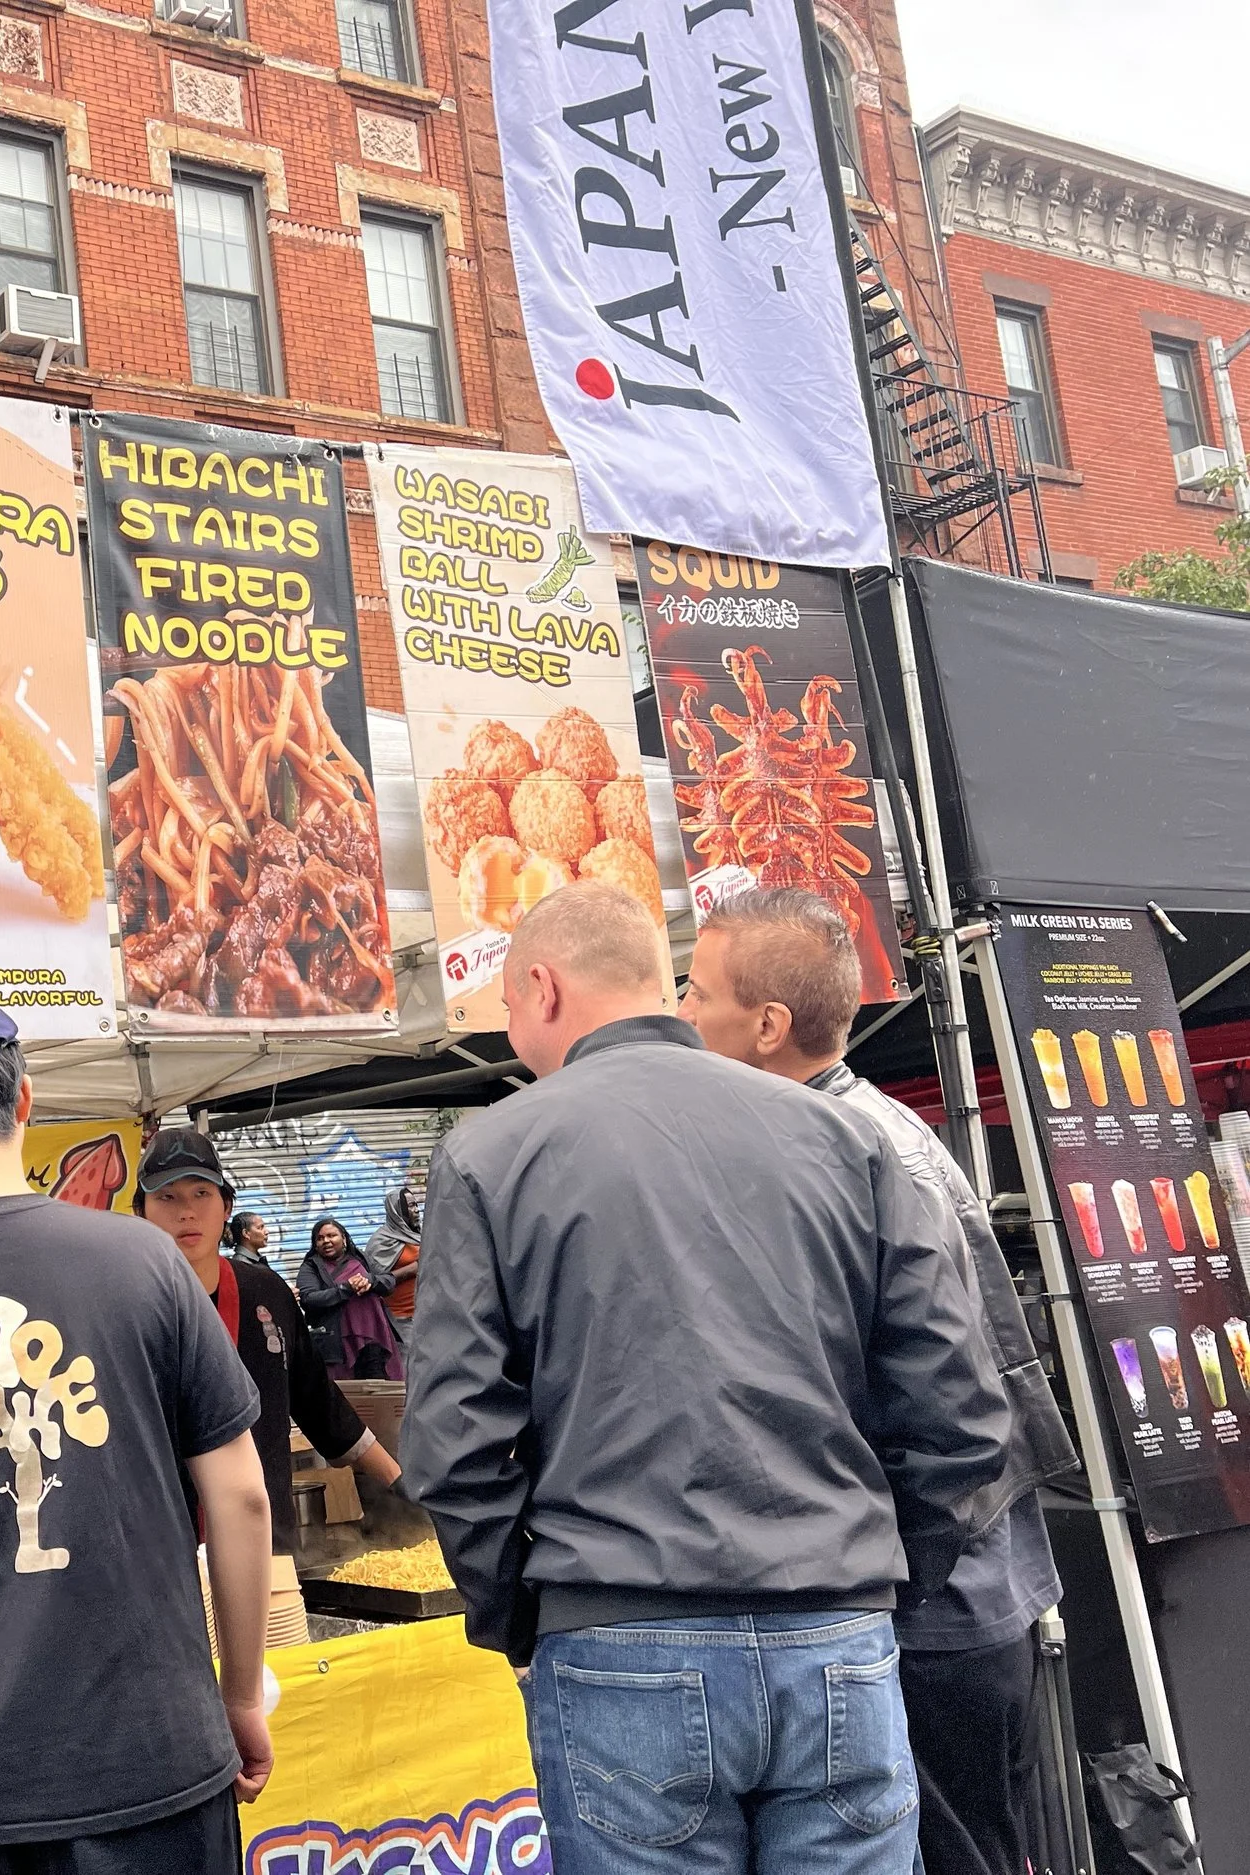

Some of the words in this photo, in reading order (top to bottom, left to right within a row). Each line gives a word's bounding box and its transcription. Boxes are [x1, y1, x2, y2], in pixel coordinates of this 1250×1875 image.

[708, 53, 796, 242] New
[98, 439, 329, 507] HIBACHI
[395, 465, 550, 529] WASABI
[118, 498, 320, 558] STAIRS
[135, 556, 312, 612] FIRED
[400, 545, 508, 595] BALL
[647, 540, 780, 592] SQUID
[123, 611, 349, 668] NOODLE
[402, 585, 500, 636] WITH
[509, 606, 621, 657] LAVA
[657, 593, 800, 629] イカの鉄板焼き
[405, 626, 571, 687] CHEESE
[1011, 914, 1039, 928] MILK
[1040, 915, 1077, 929] GREEN
[1077, 917, 1098, 929] TEA
[1098, 917, 1133, 931] SERIES
[1048, 933, 1075, 942] PREMIUM
[1075, 934, 1088, 942] SIZE
